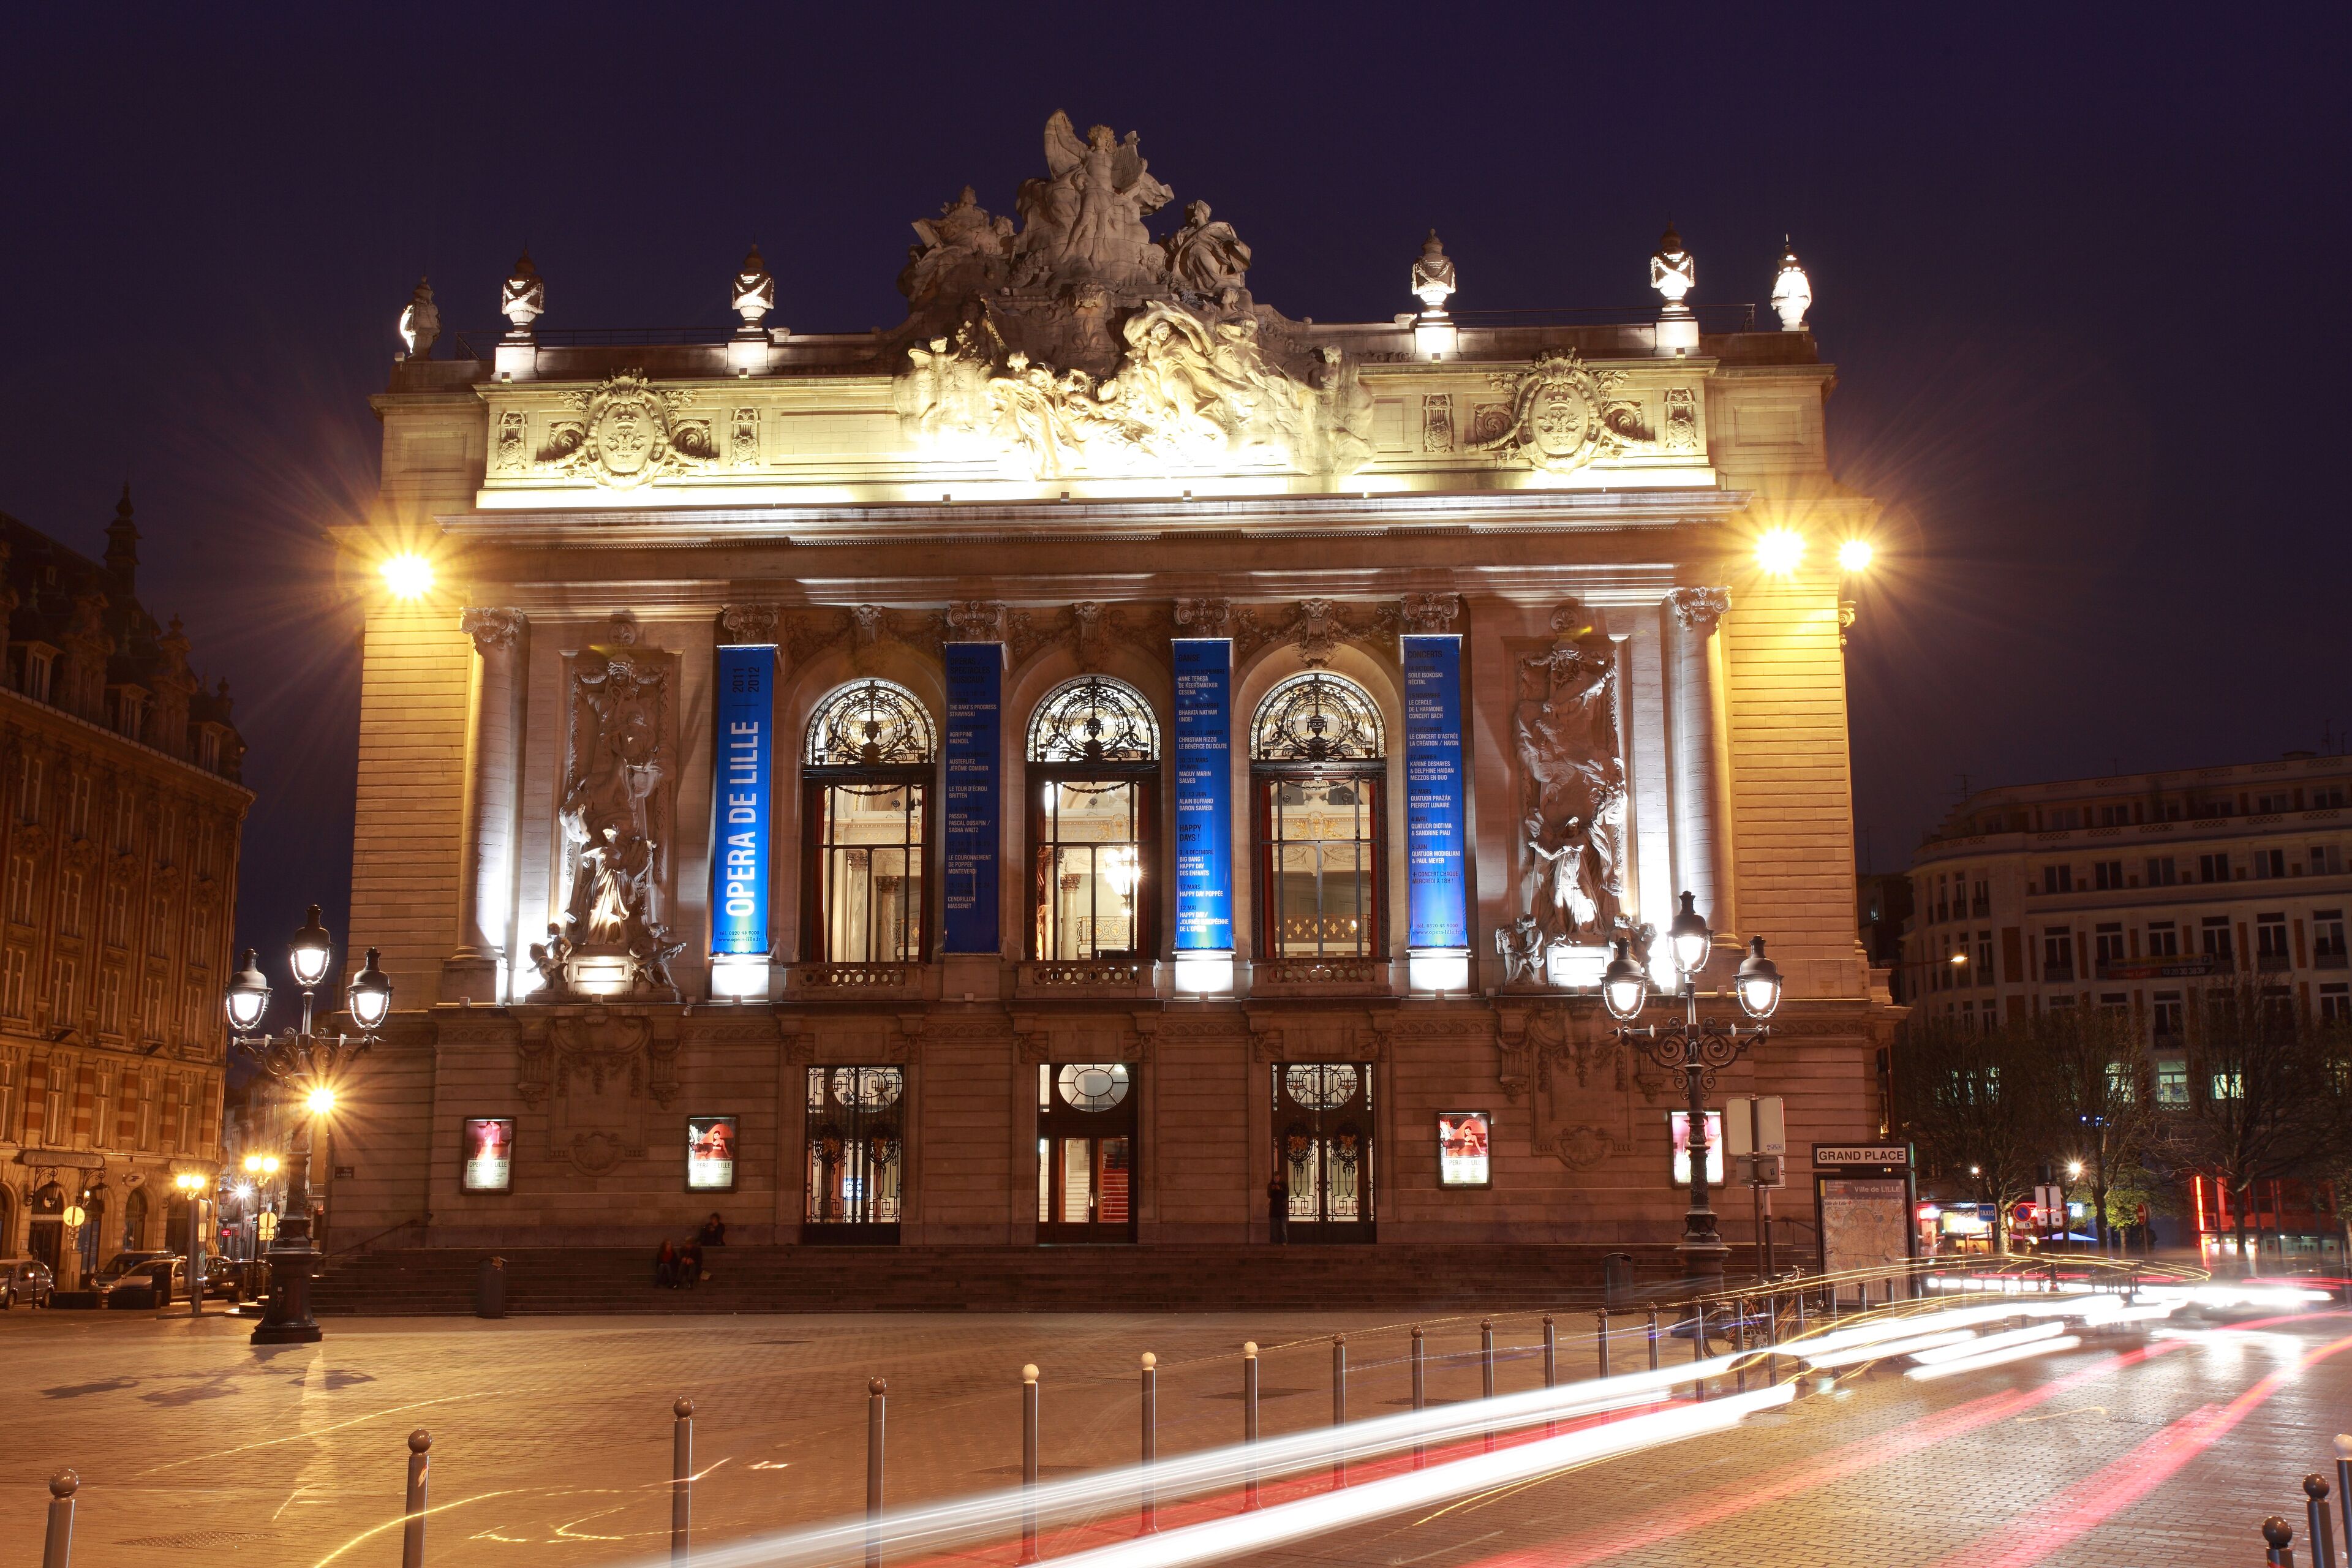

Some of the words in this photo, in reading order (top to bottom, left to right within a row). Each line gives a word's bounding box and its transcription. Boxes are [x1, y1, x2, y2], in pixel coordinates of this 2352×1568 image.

[733, 668, 744, 693] 2011
[748, 666, 760, 693] 2012
[729, 722, 758, 784] LILLE
[729, 793, 756, 823] DE
[726, 831, 756, 917] OPERA
[1819, 1151, 1861, 1160] GRAND
[1865, 1151, 1904, 1160] PLACE
